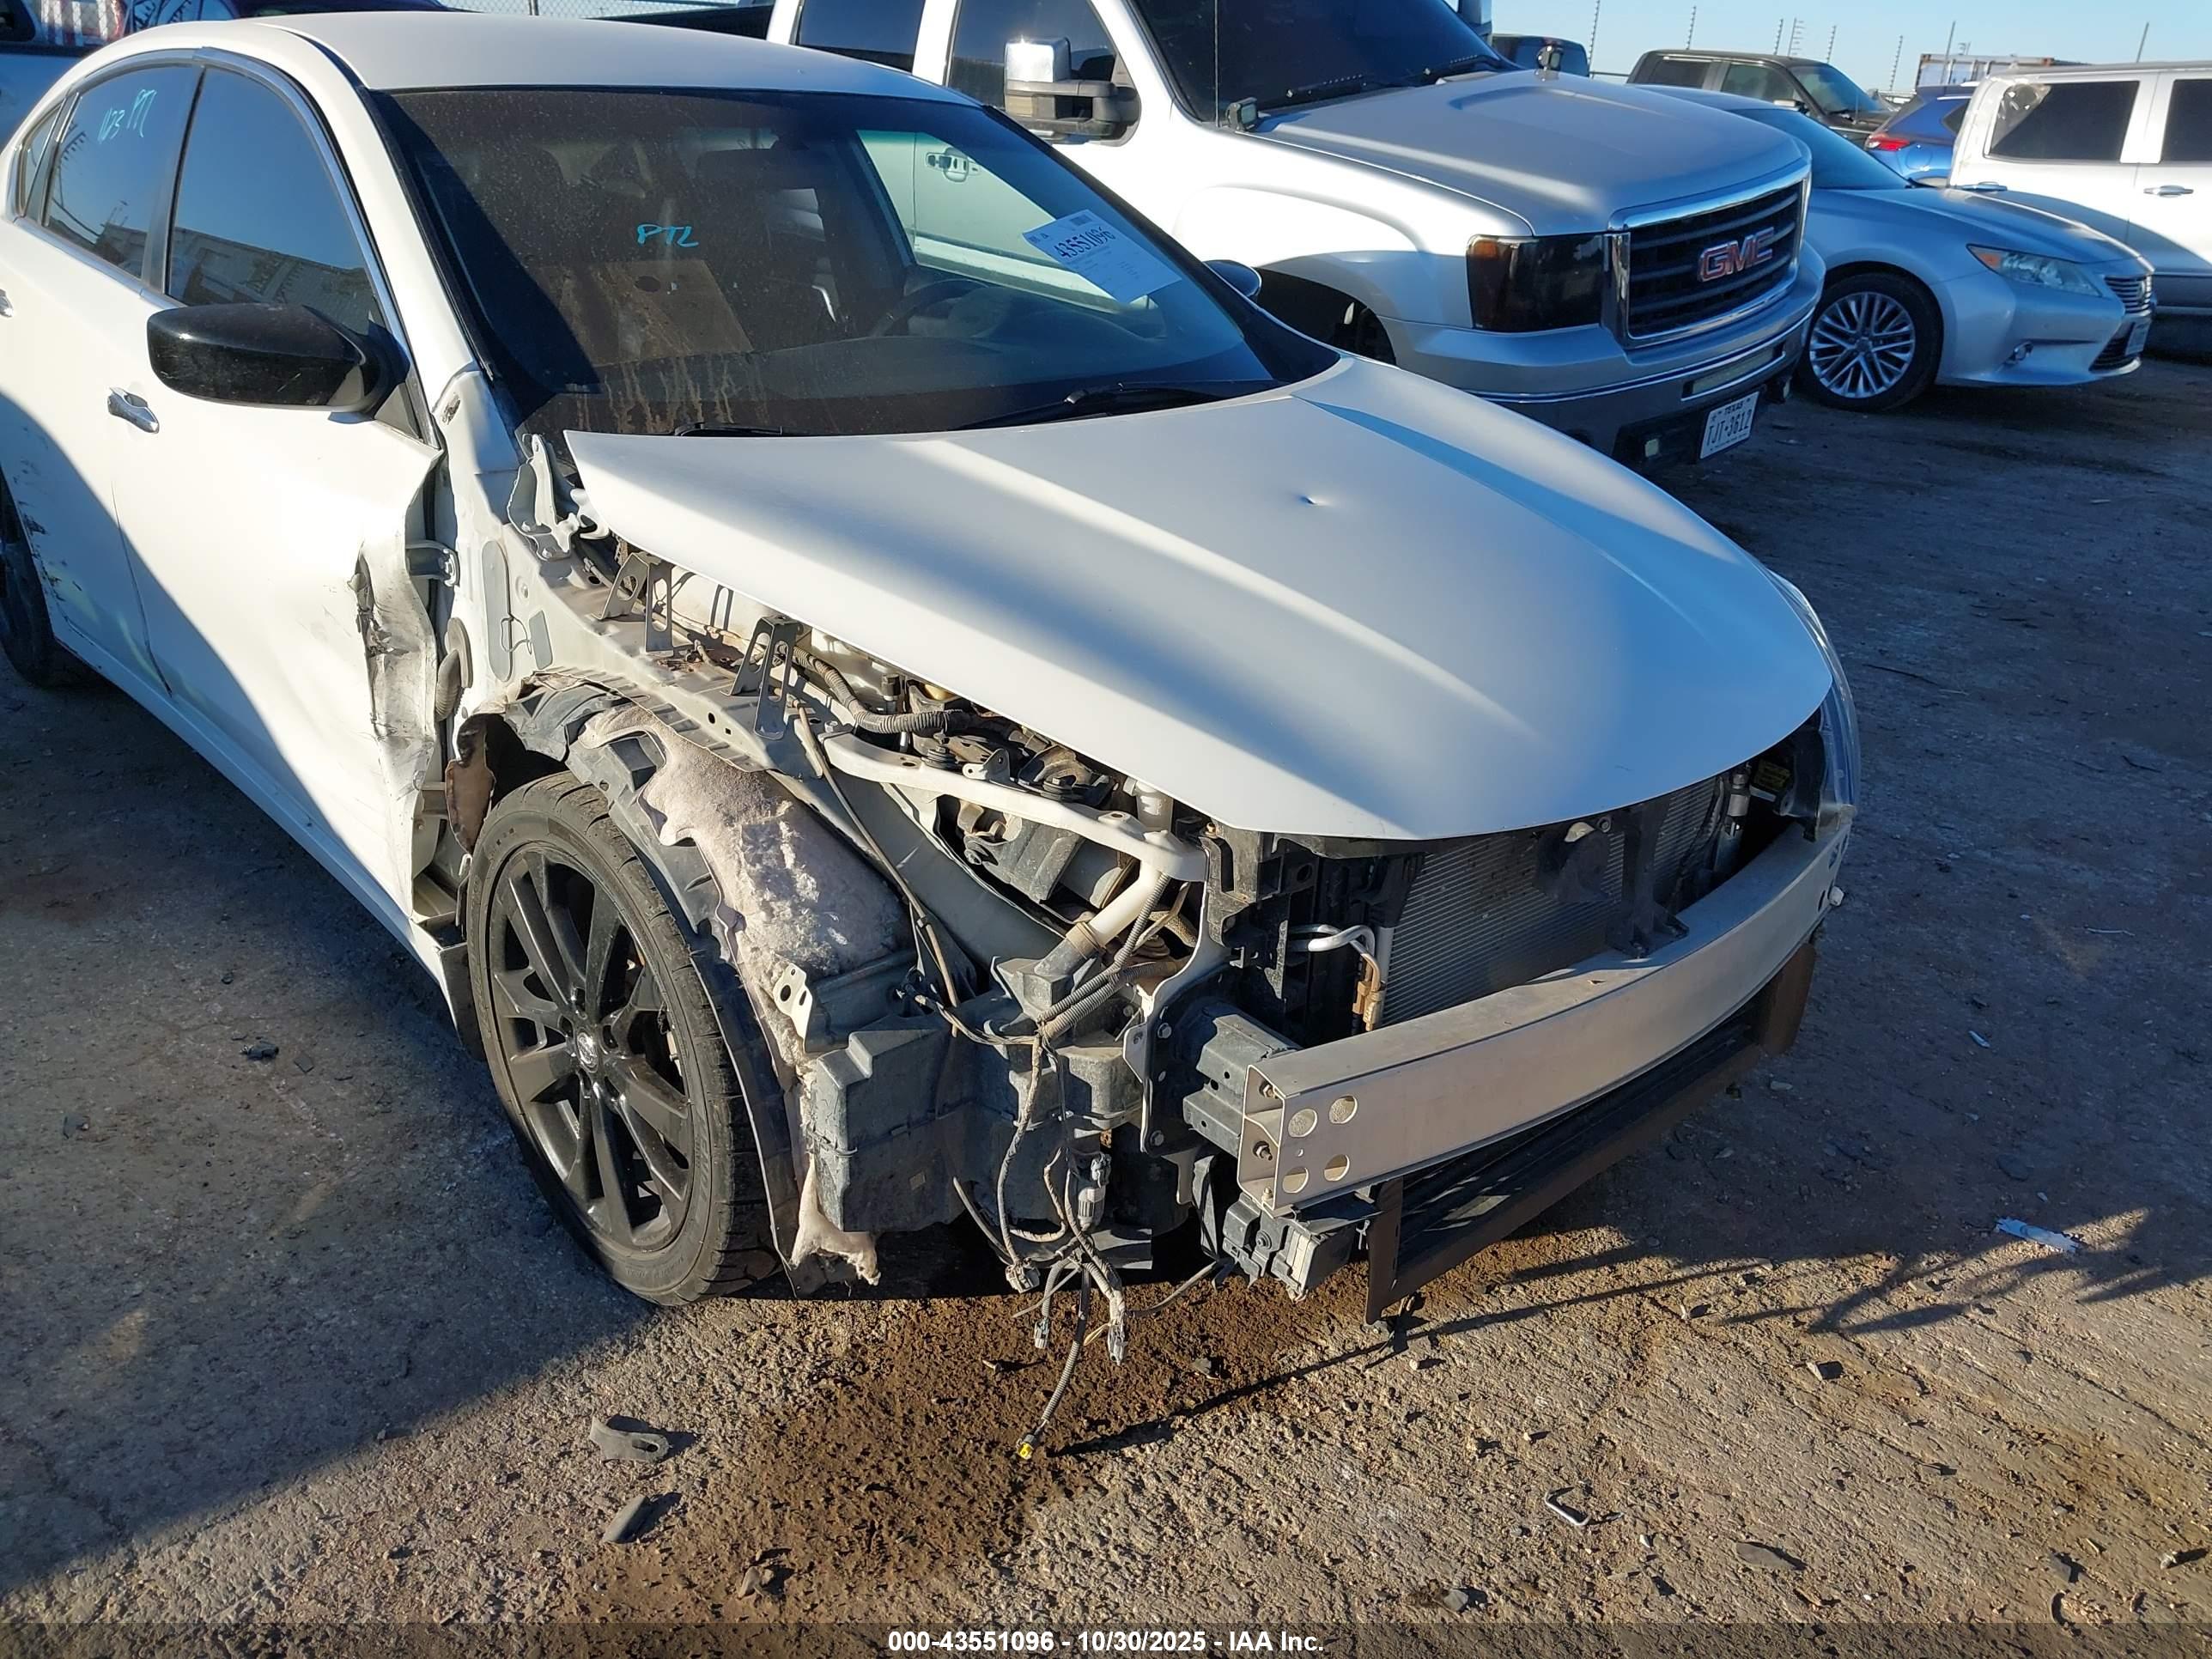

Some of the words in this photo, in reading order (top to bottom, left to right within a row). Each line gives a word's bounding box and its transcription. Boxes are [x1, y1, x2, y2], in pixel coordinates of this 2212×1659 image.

[1054, 225, 1116, 258] 43551096
[1698, 227, 1774, 282] GMC
[1724, 401, 1745, 415] TEXAS
